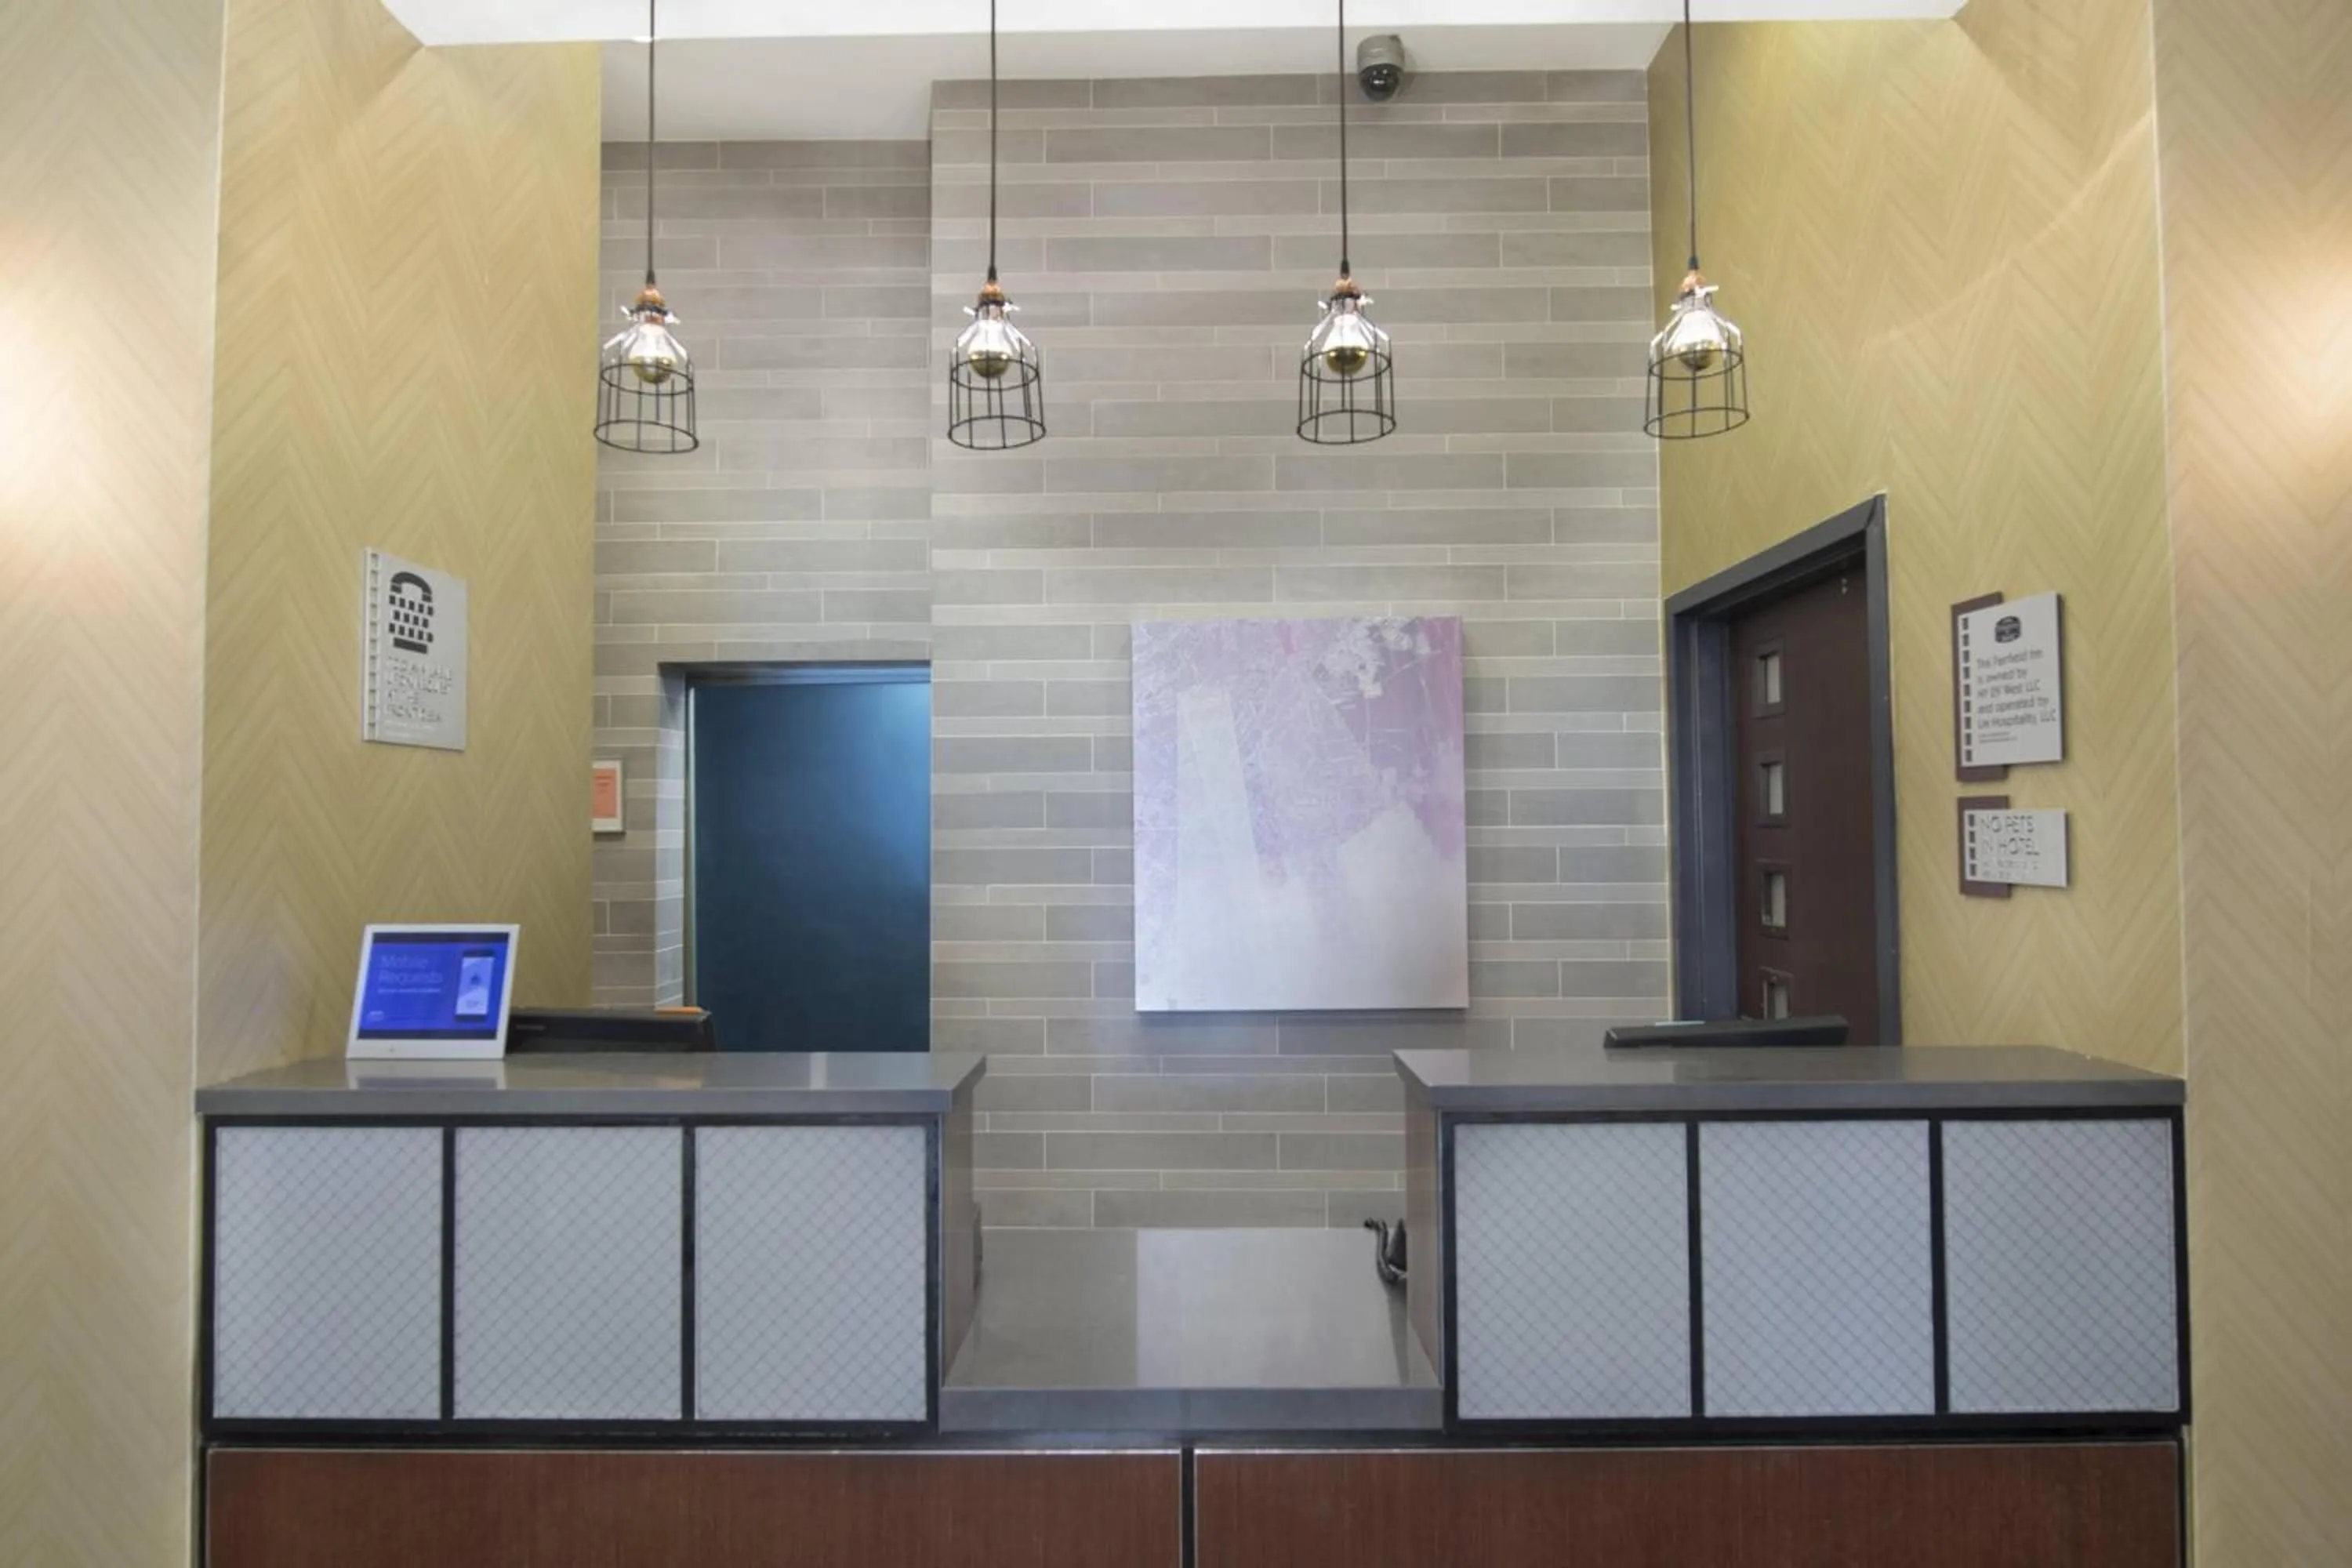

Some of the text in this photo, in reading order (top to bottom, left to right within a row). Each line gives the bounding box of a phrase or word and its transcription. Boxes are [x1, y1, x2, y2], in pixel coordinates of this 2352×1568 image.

[2025, 679, 2040, 692] LLC
[2040, 707, 2056, 722] LLC
[1980, 814, 2034, 833] NO PETS
[1997, 837, 2040, 856] HOTEL
